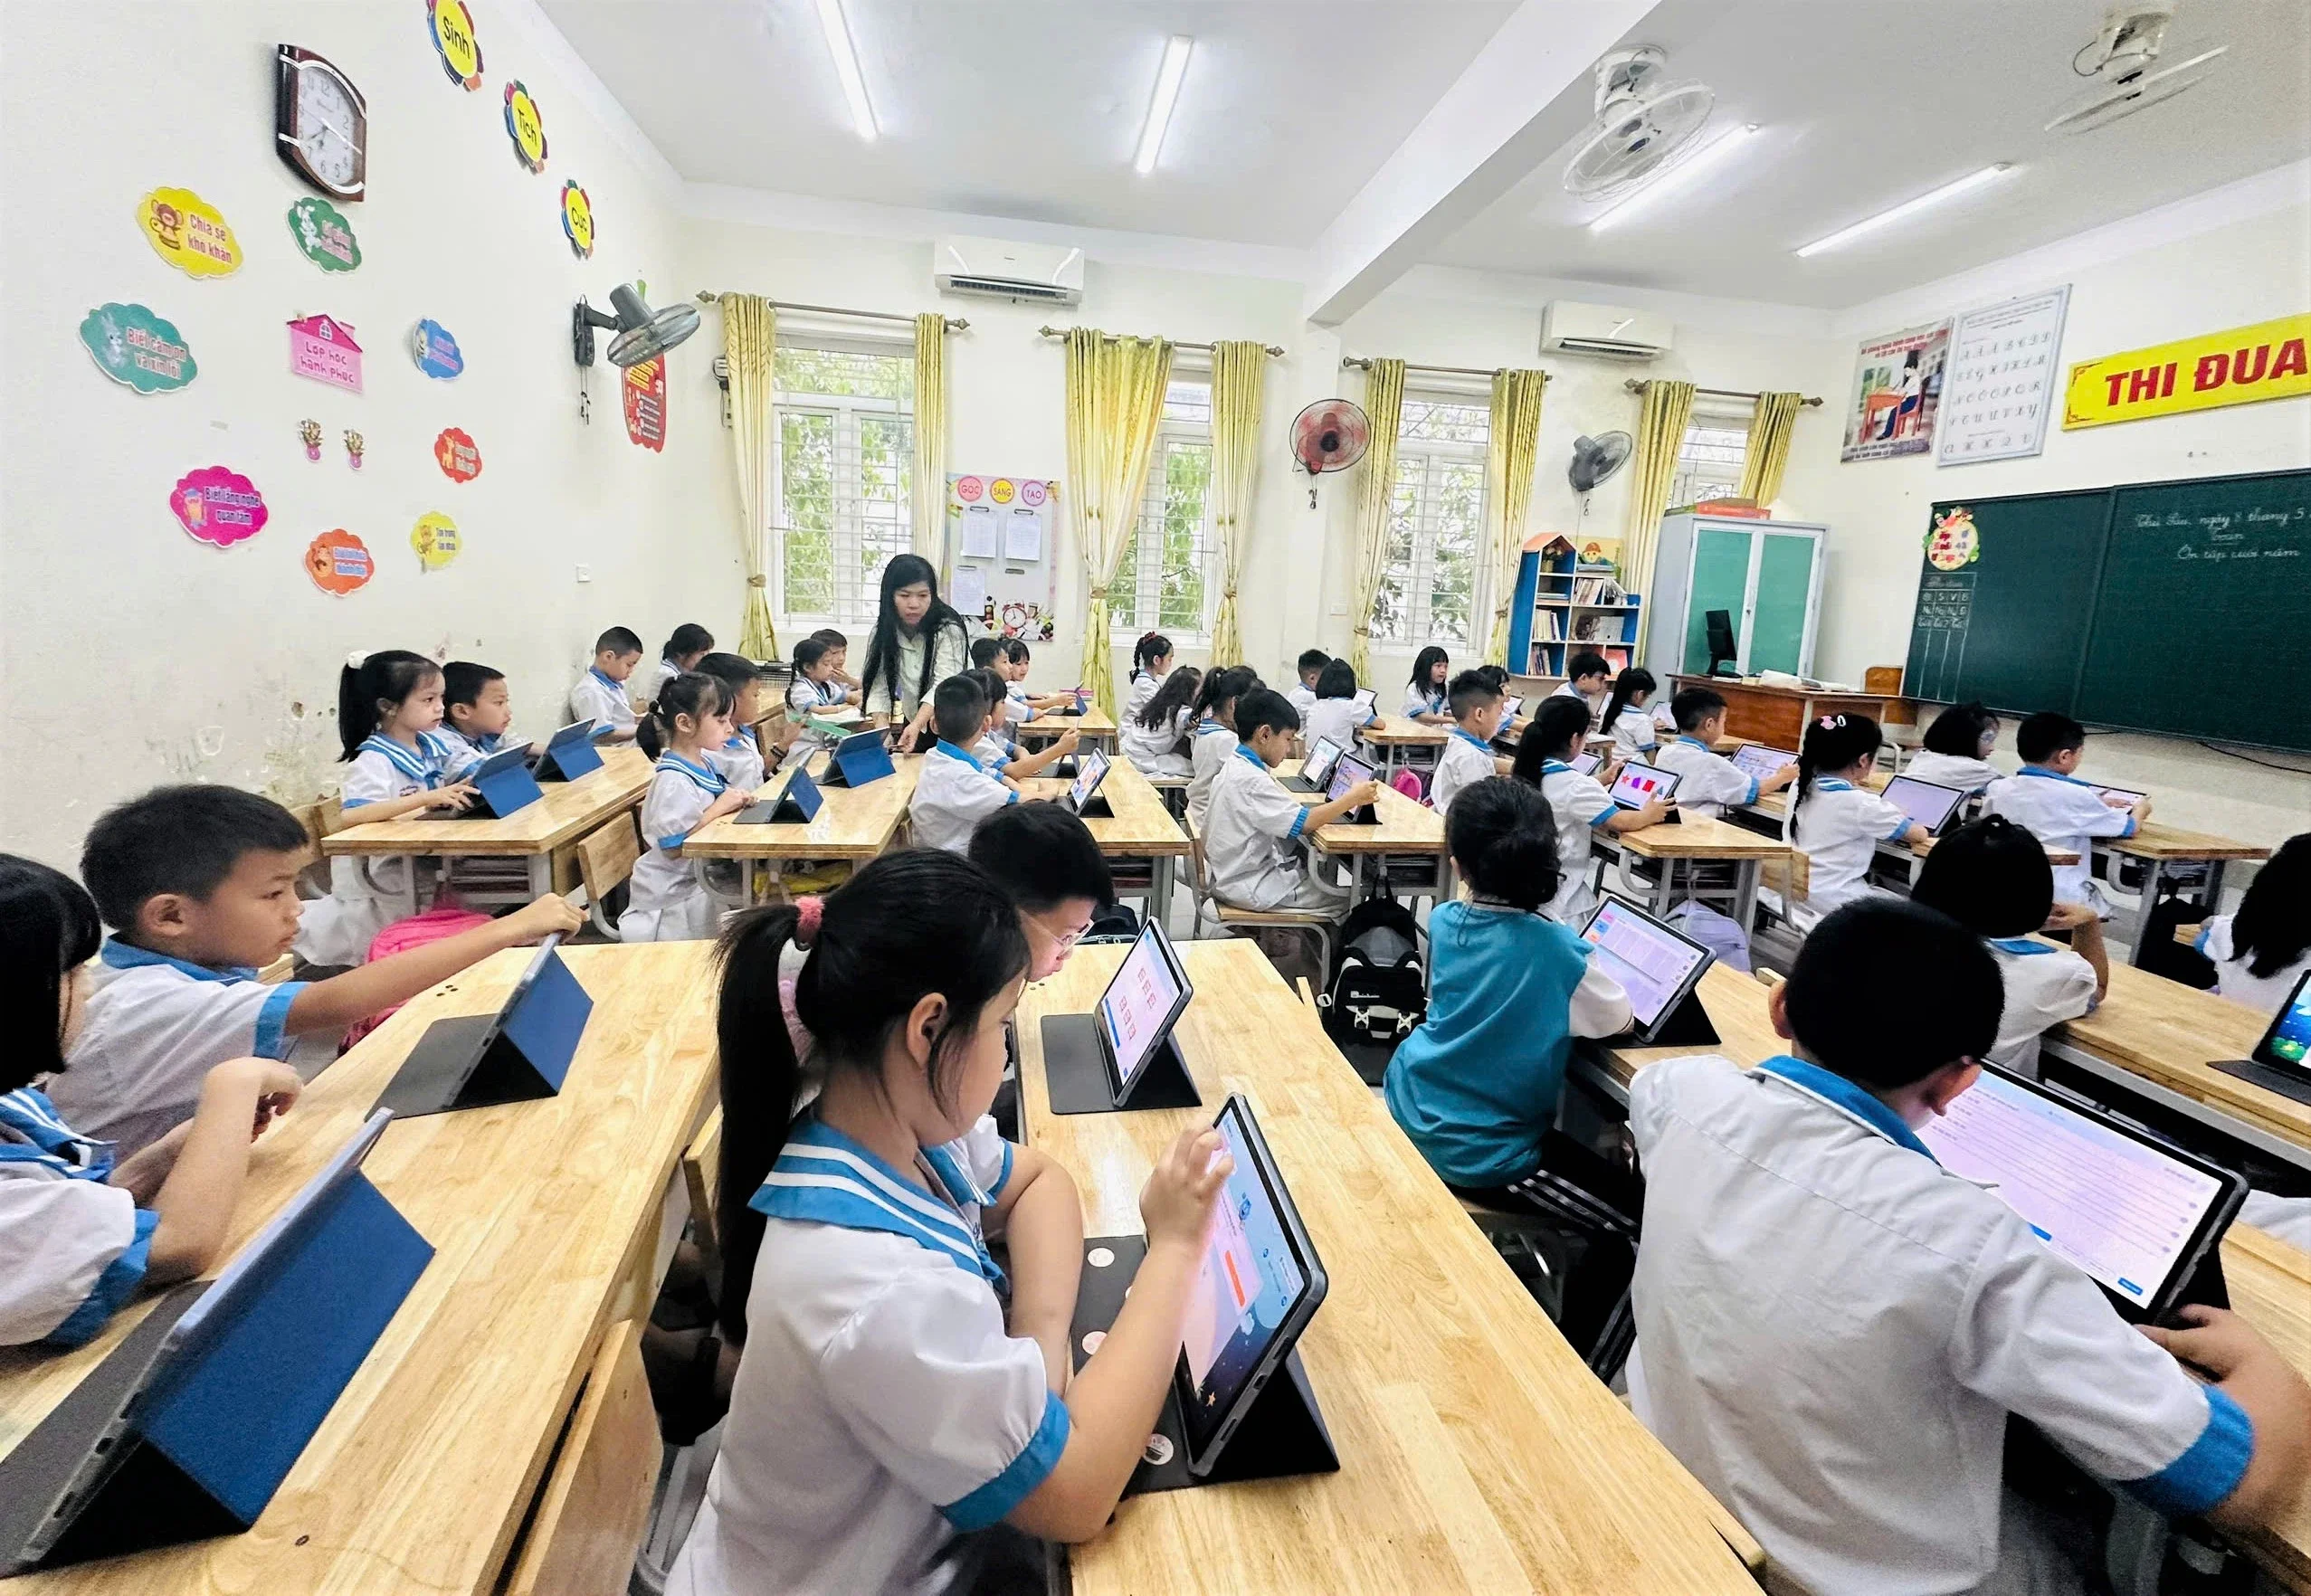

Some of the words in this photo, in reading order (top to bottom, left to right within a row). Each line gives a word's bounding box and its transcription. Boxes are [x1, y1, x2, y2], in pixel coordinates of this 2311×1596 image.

[443, 16, 471, 60] Sinh
[190, 214, 213, 236] Chia
[2105, 363, 2178, 407] THI
[2193, 338, 2308, 393] ĐUA
